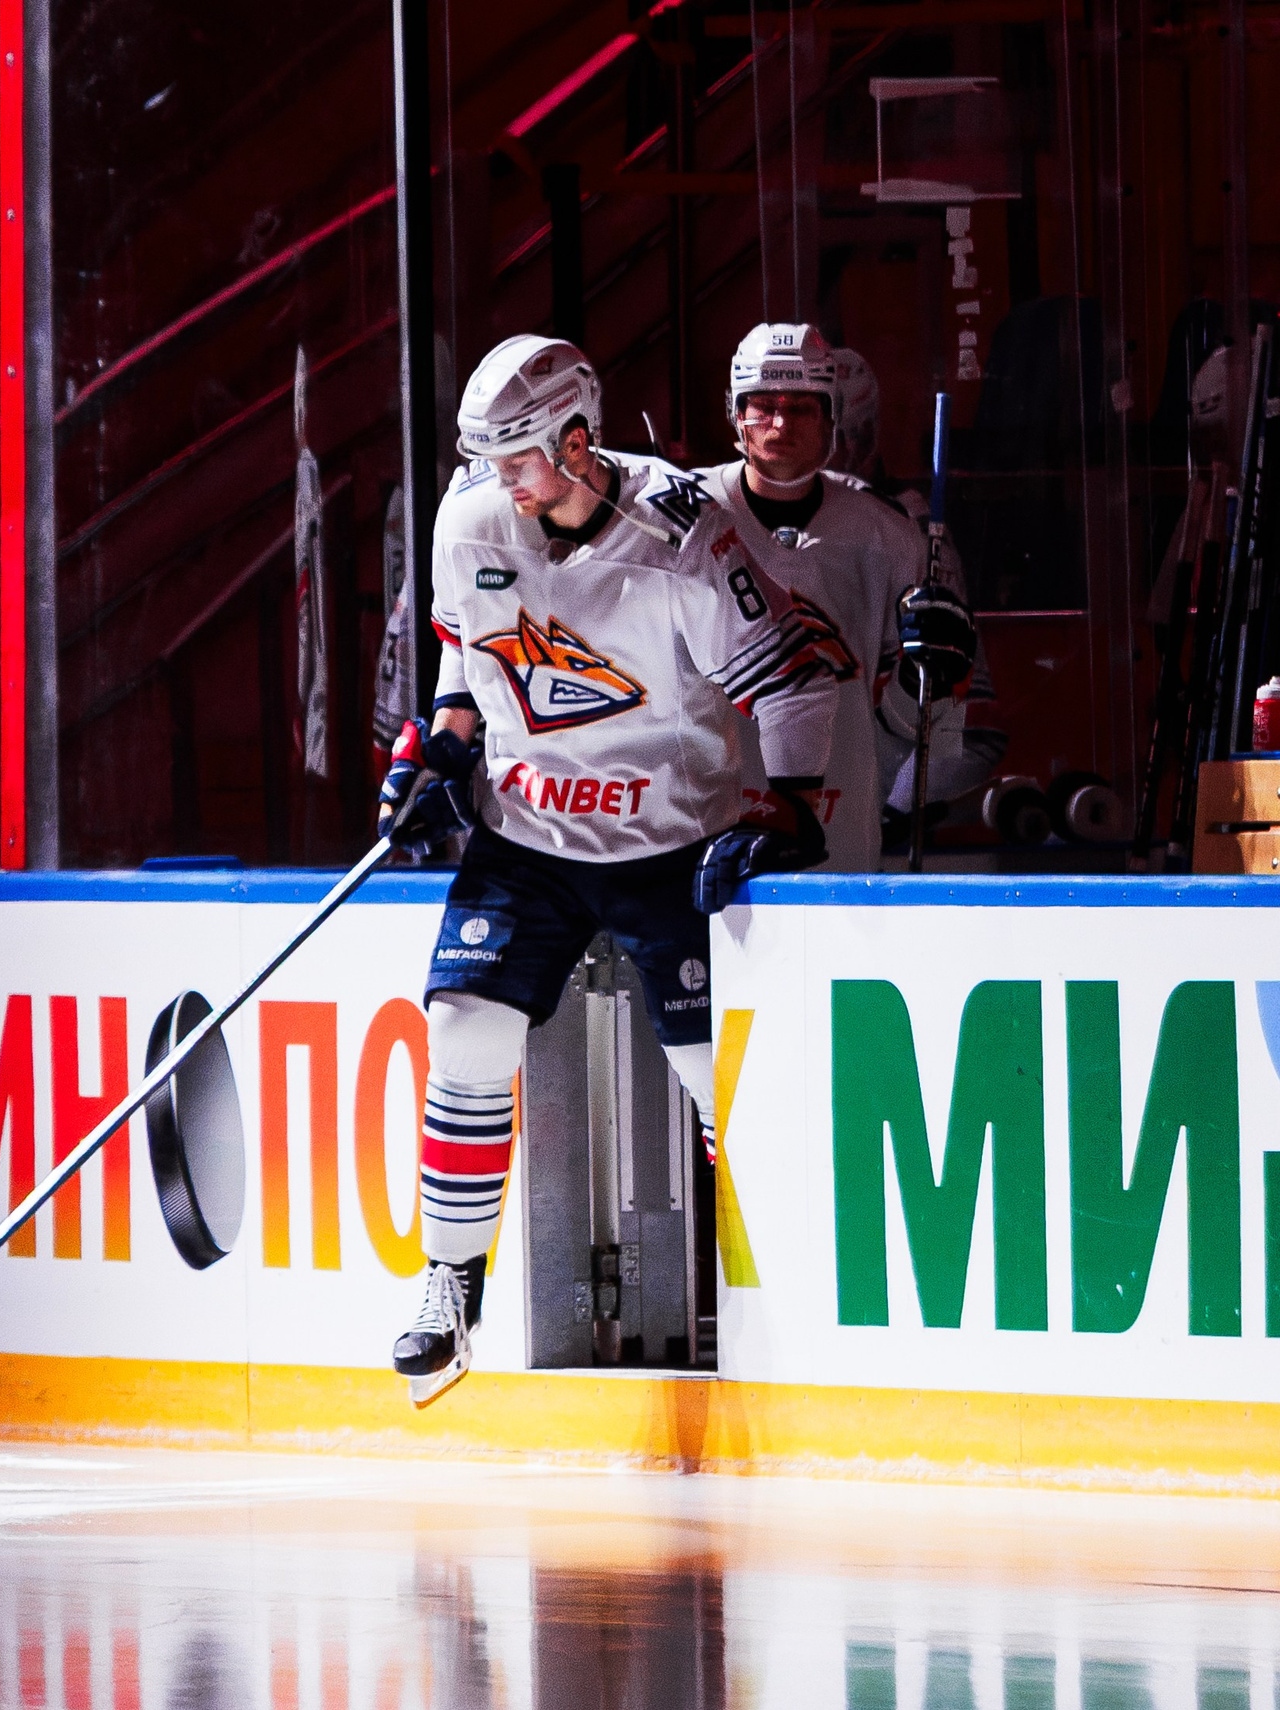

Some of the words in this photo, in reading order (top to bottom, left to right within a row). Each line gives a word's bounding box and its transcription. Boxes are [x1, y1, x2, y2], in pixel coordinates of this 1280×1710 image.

[772, 334, 793, 346] 58
[728, 566, 768, 621] 8
[499, 762, 650, 815] FONBET
[436, 948, 503, 964] МЕГАФОН
[665, 997, 710, 1012] МЕГАФ
[831, 979, 1280, 1340] МИ
